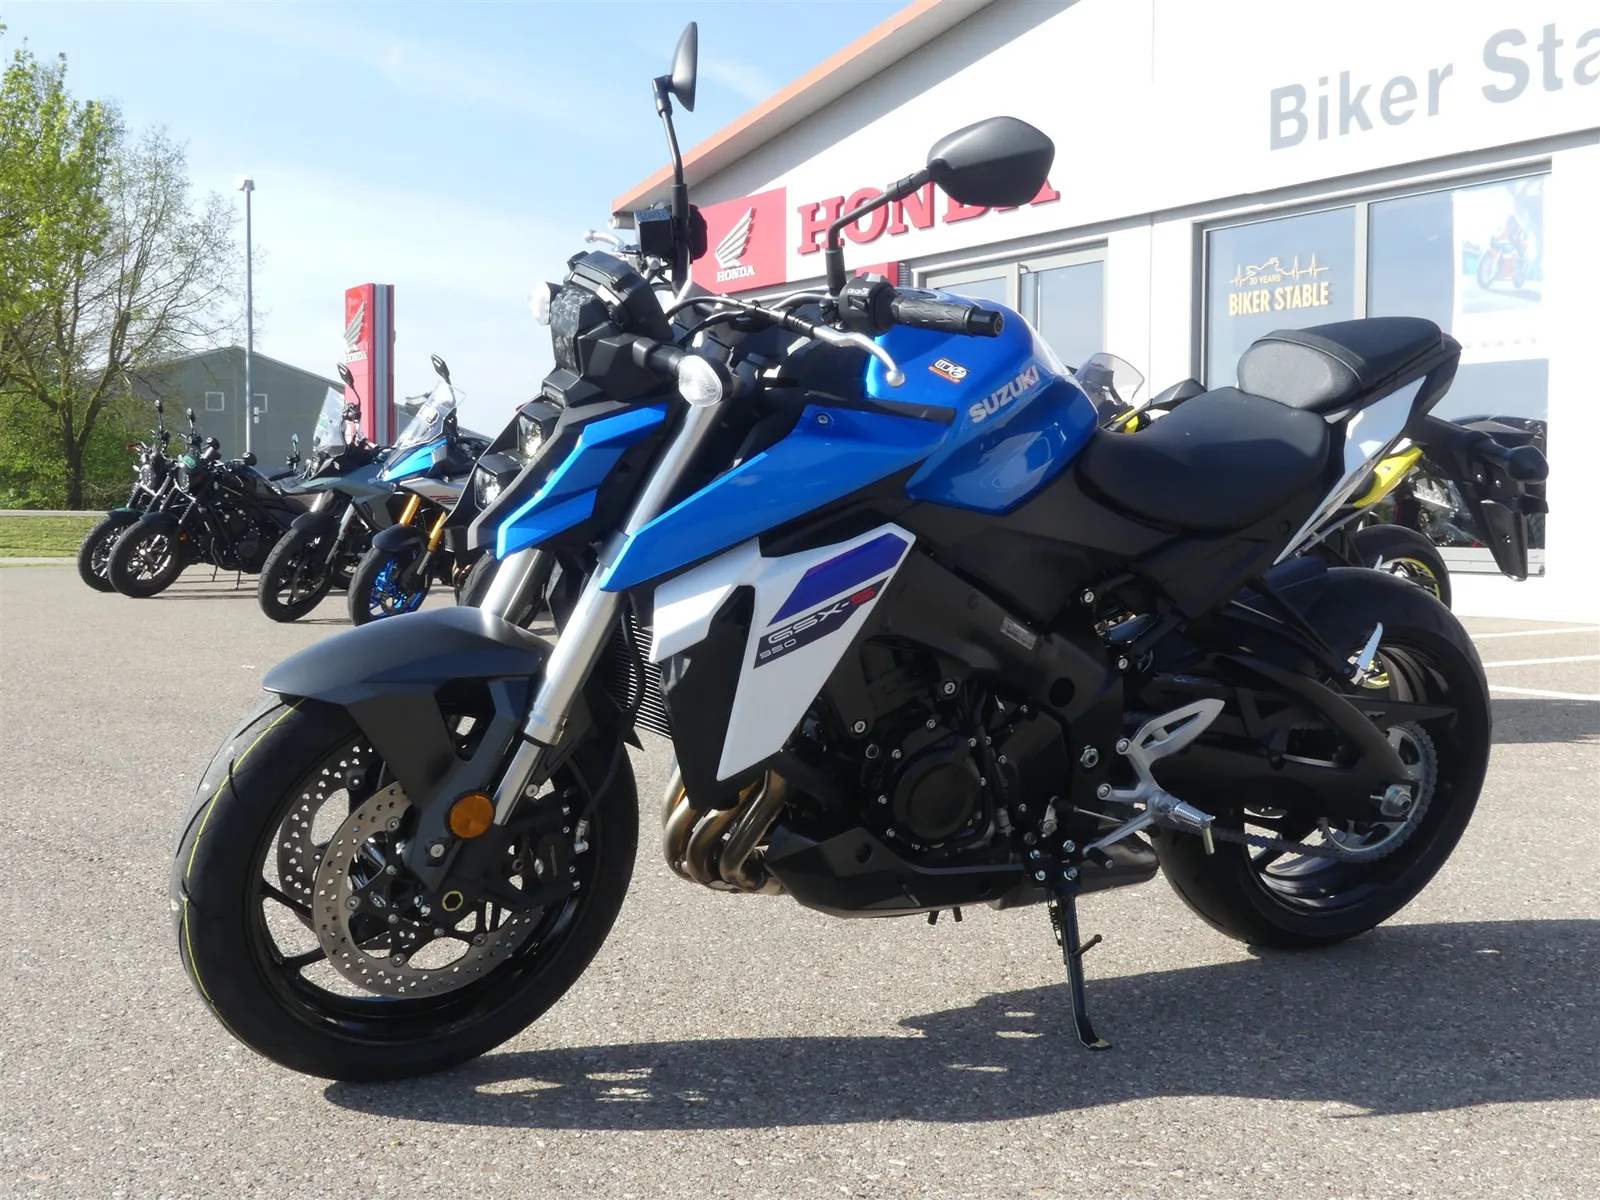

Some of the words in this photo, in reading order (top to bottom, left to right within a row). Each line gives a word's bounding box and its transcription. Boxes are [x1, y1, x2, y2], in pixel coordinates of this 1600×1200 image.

[1270, 62, 1454, 151] Biker
[1481, 22, 1600, 104] Sta
[797, 176, 1061, 255] HON
[716, 265, 756, 282] HONDA
[1259, 274, 1281, 284] YEARS
[1229, 289, 1270, 316] BIKER
[1274, 281, 1329, 311] STABLE
[968, 365, 1040, 424] SUZUKI
[760, 638, 797, 659] 950
